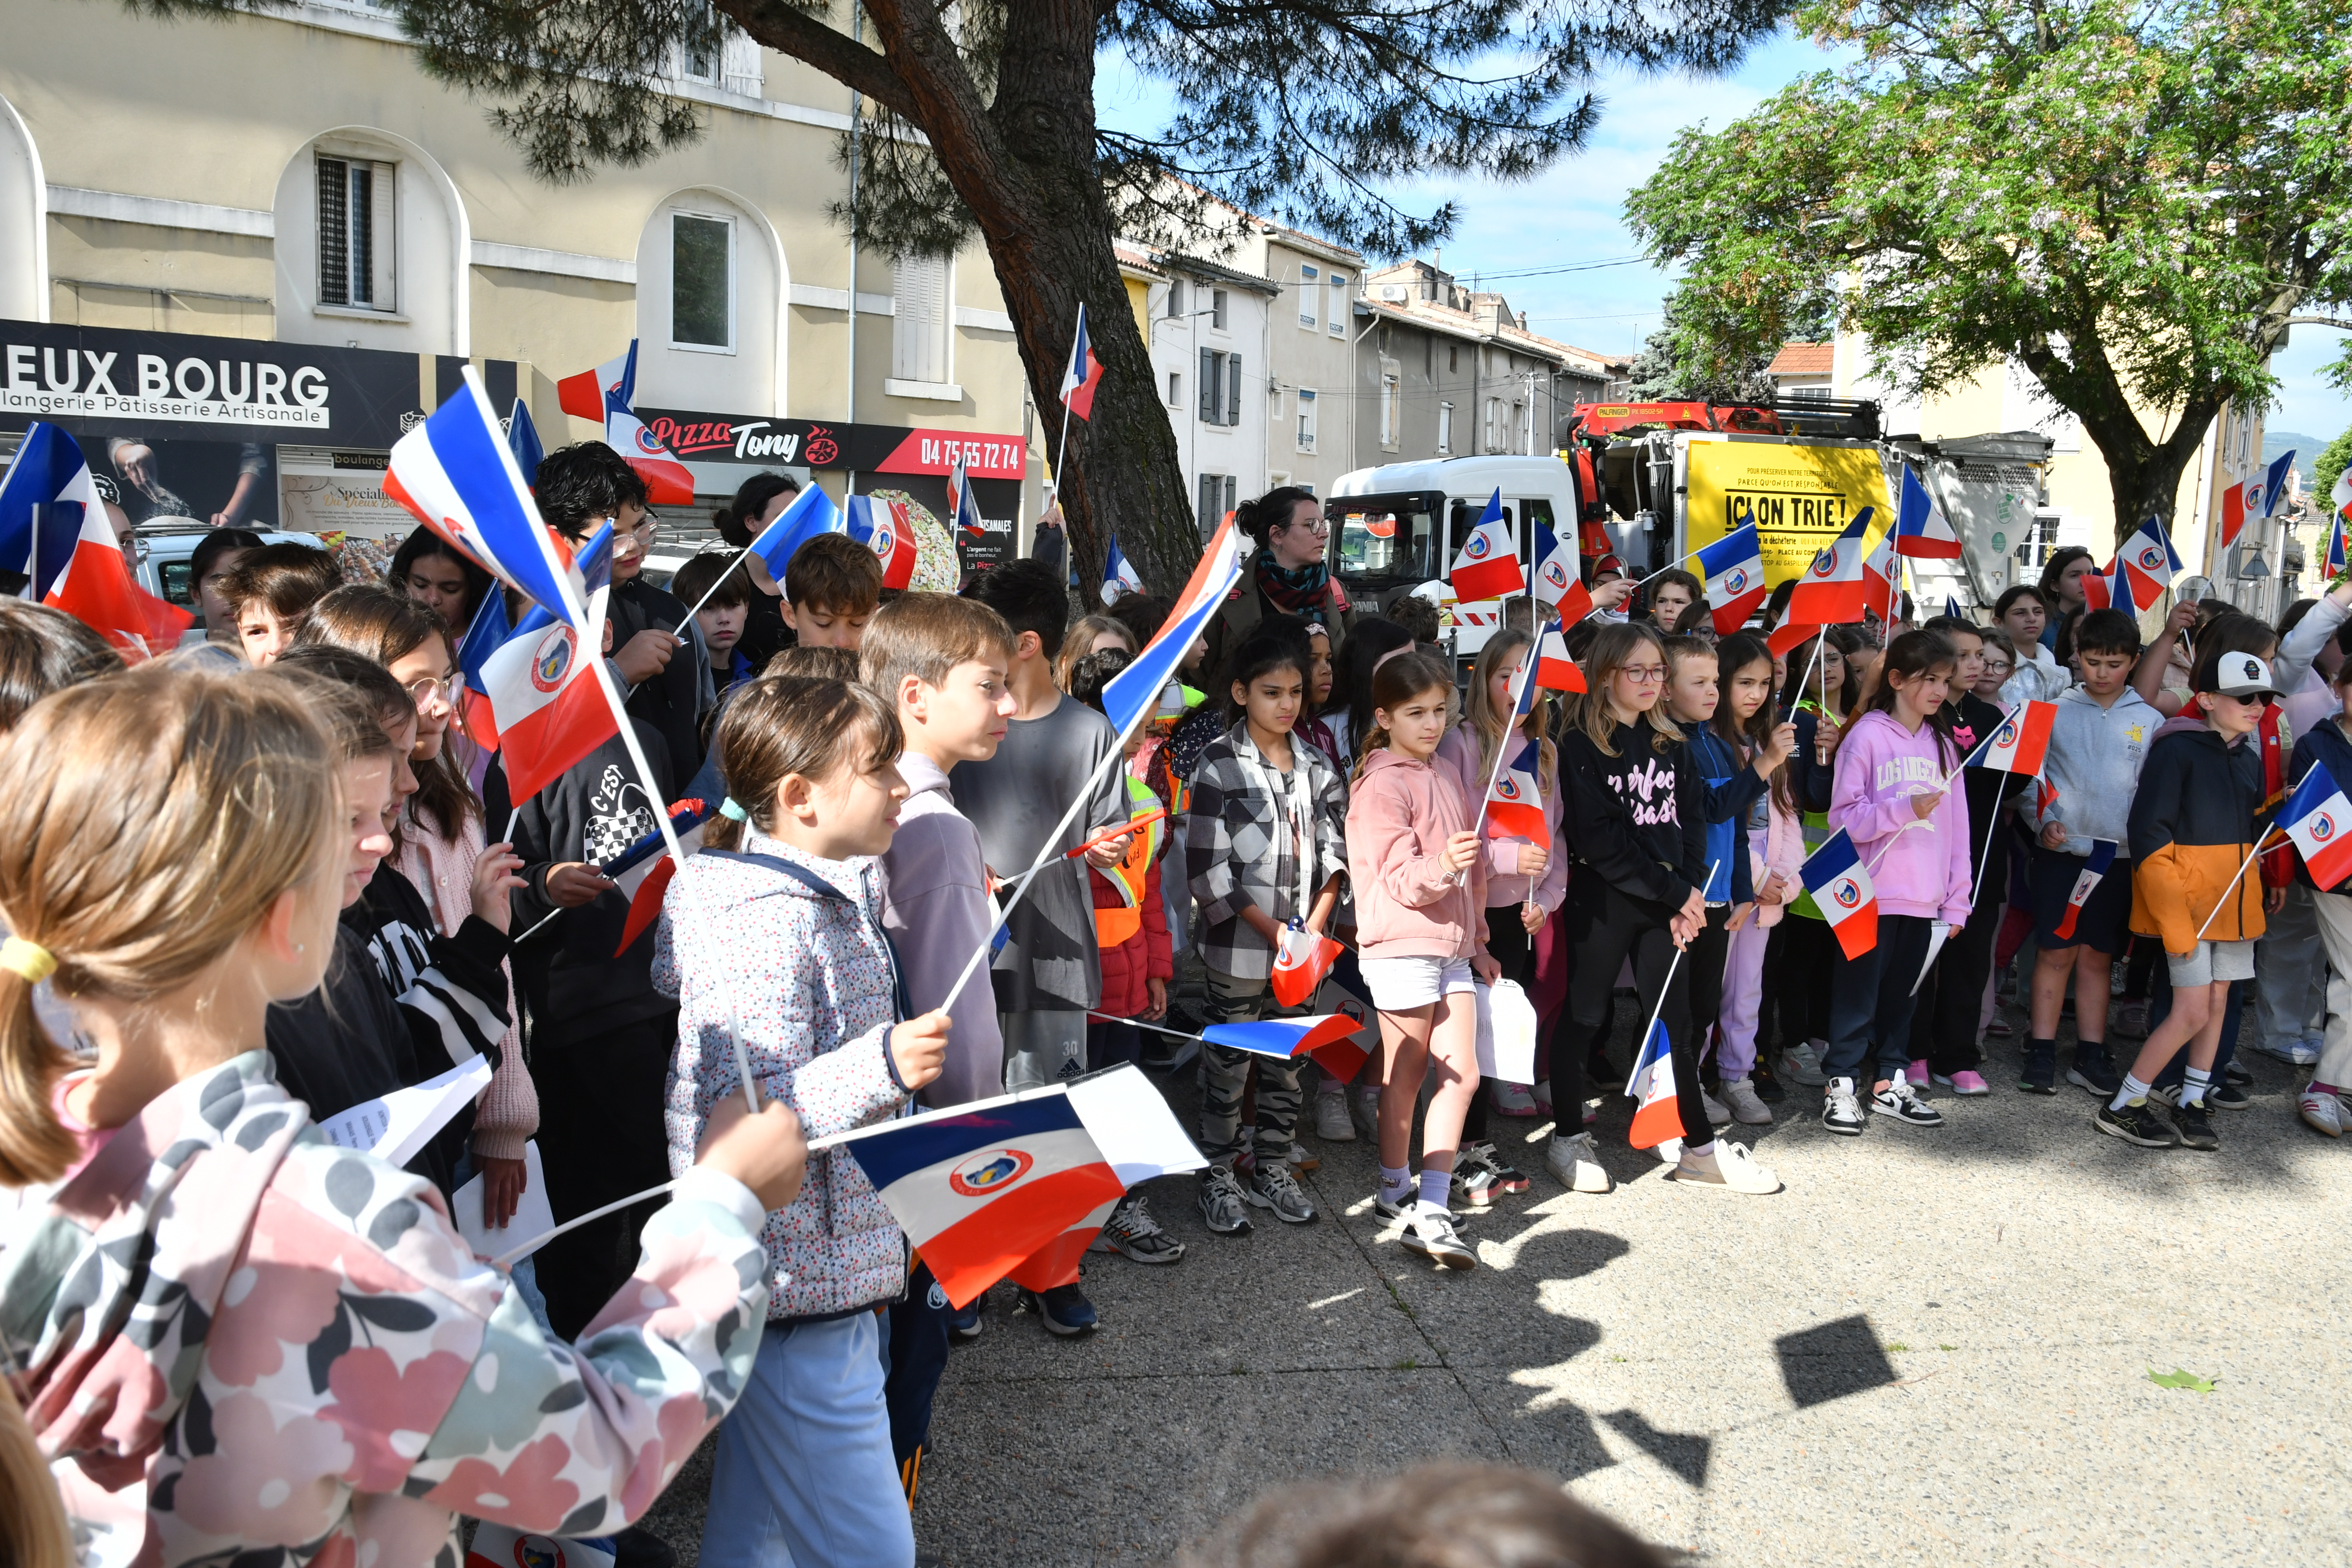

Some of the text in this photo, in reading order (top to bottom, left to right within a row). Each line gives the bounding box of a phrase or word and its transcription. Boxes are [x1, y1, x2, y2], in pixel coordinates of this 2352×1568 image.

[7, 344, 328, 407] EUX BOURG
[3, 390, 320, 422] langerie Pâtisserie Artisanale
[651, 417, 799, 463] Pizza Tony
[921, 438, 940, 465] 04
[944, 440, 960, 466] 75
[984, 443, 999, 468] 72
[1003, 444, 1018, 469] 74
[1761, 467, 1786, 475] PRÉSERVER
[1796, 481, 1838, 489] RESPONSABLE
[323, 494, 341, 507] Du
[343, 494, 378, 508] Vieux
[1759, 497, 1783, 525] ON
[1791, 498, 1835, 527] TRIE
[1763, 534, 1796, 545] la déchèterie
[966, 561, 975, 569] La
[532, 662, 546, 690] FRANÇAIS
[2128, 745, 2141, 753] #025
[1877, 758, 1902, 791] LOS
[591, 764, 625, 811] C'EST
[1062, 1041, 1078, 1056] 30
[1057, 1069, 1085, 1078] adidas
